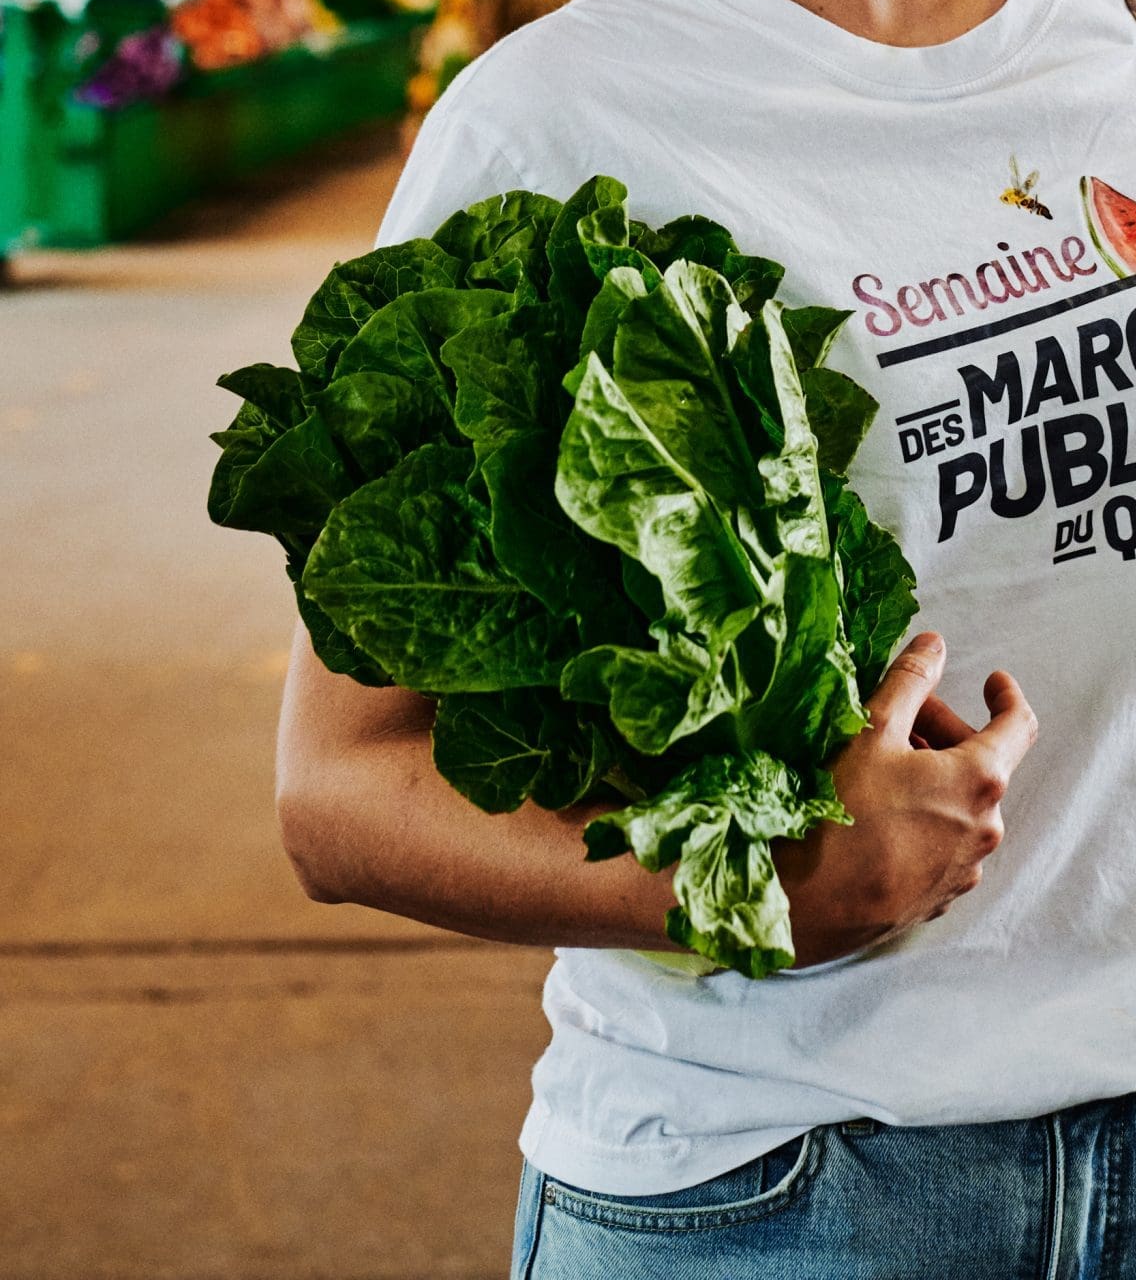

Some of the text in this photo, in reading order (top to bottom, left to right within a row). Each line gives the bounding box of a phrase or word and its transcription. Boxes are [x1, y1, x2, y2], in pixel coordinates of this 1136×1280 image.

[852, 236, 1097, 336] Semaine
[898, 412, 966, 463] DES
[1055, 509, 1094, 552] DU
